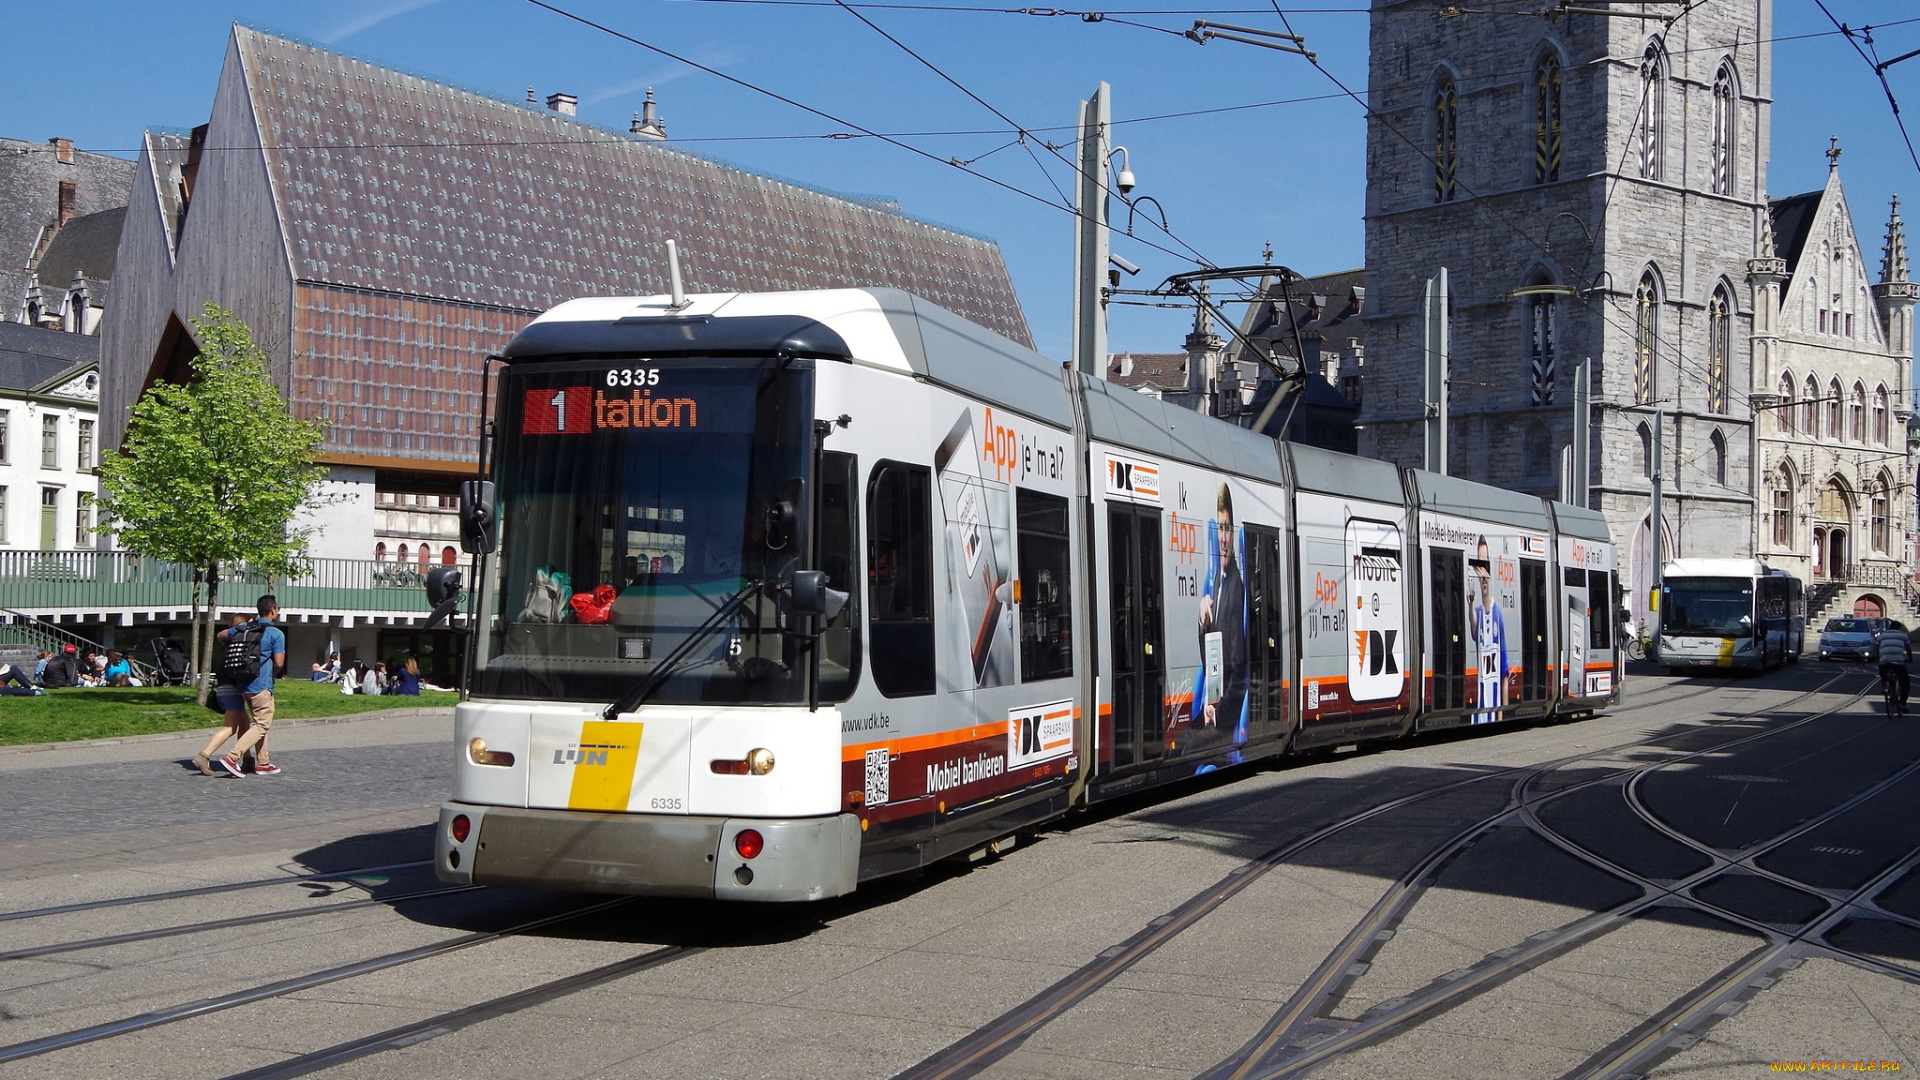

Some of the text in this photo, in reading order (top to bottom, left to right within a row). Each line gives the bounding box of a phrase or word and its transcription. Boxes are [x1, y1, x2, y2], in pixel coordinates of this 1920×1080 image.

[606, 368, 660, 387] 6335
[551, 389, 697, 431] 1 tation
[983, 407, 1017, 484] App
[1021, 434, 1031, 482] je
[1050, 445, 1064, 481] al?
[1170, 511, 1196, 565] App
[1424, 520, 1477, 546] Mobiel bankieren
[1572, 538, 1584, 567] App
[1353, 554, 1397, 582] mobile
[1498, 555, 1514, 588] App
[1190, 569, 1198, 597] al
[1315, 571, 1337, 610] App
[1371, 592, 1380, 617] @
[1309, 608, 1318, 639] jij
[1333, 608, 1345, 632] al?
[841, 711, 890, 733] www.vdk.be
[926, 752, 1004, 794] Mobiel bankieren
[651, 797, 682, 810] 6335
